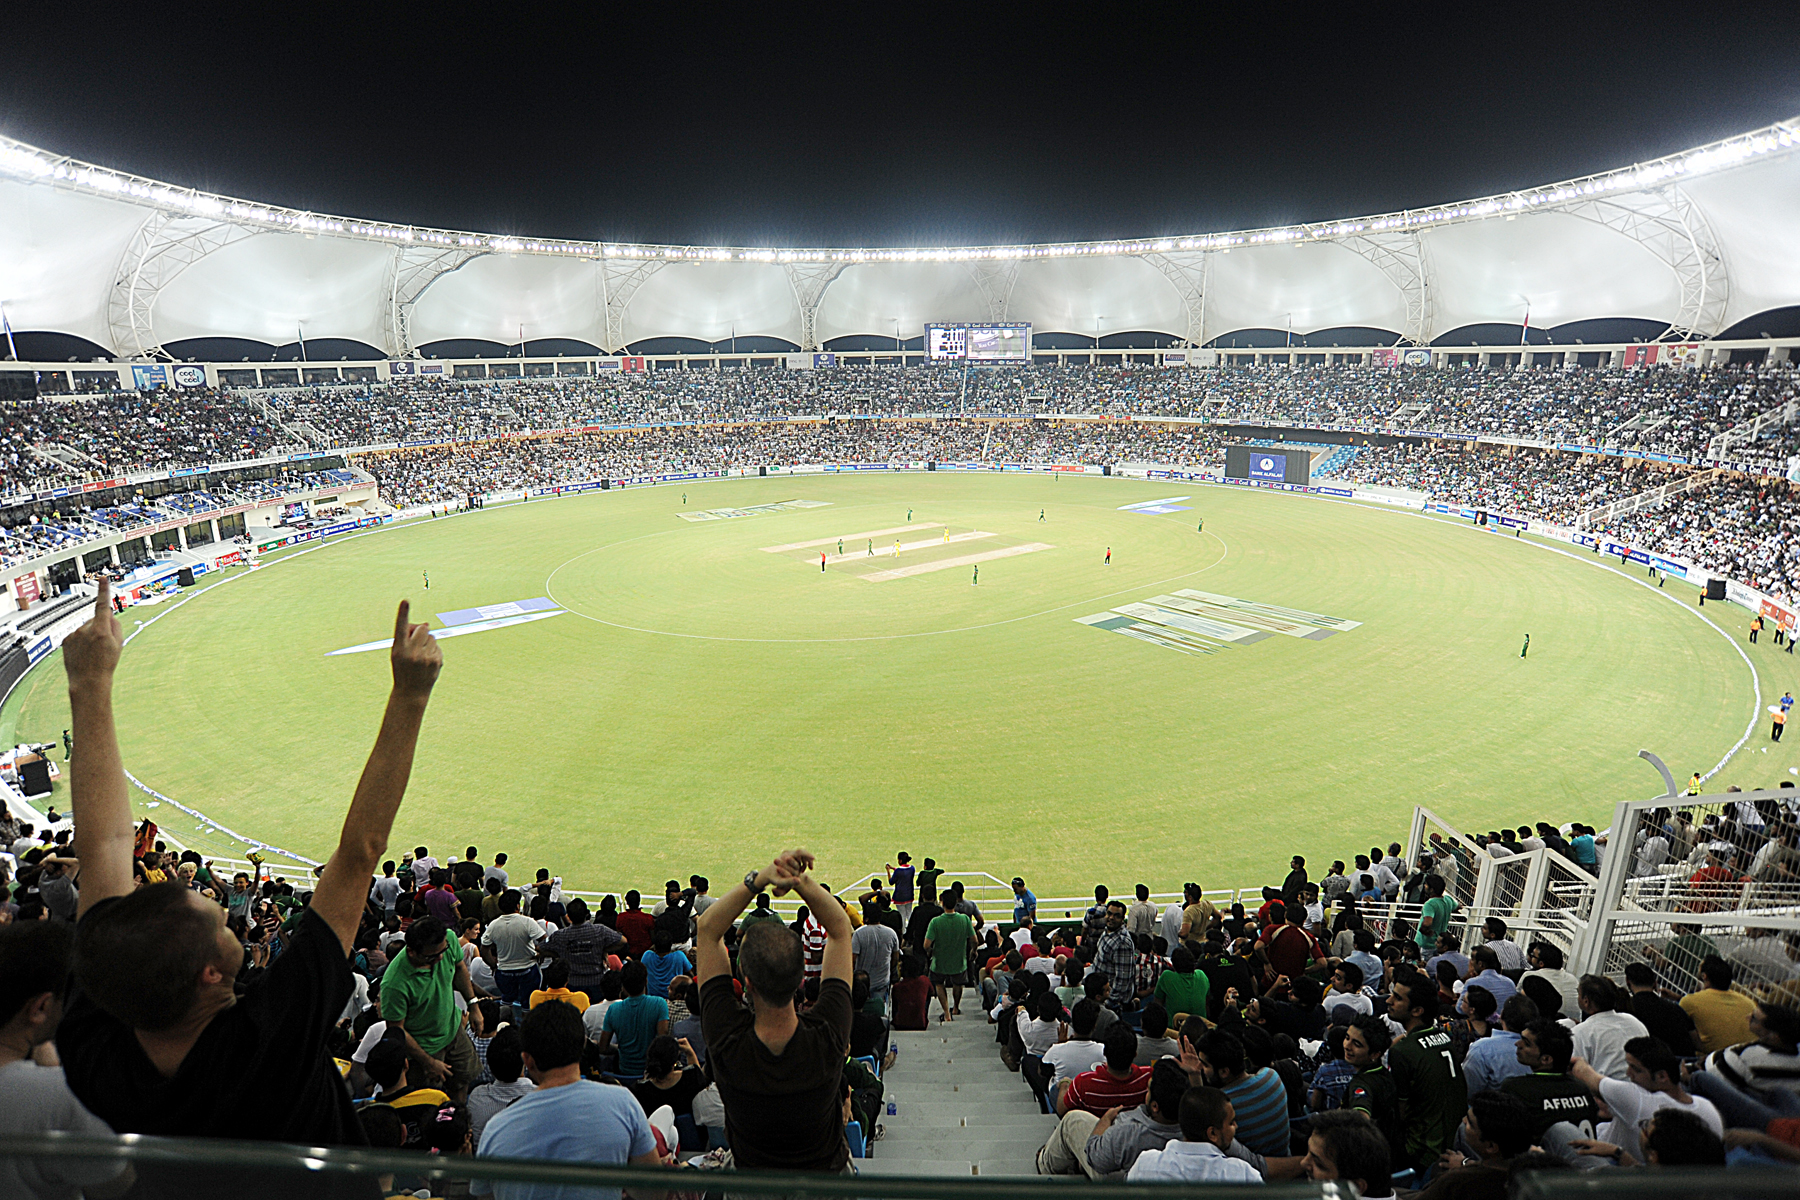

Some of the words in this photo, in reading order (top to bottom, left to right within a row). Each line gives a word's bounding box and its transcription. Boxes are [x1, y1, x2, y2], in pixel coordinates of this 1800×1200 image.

[1418, 1032, 1451, 1049] FARHAN
[1440, 1050, 1456, 1078] 7
[1543, 1096, 1589, 1110] AFRIDI
